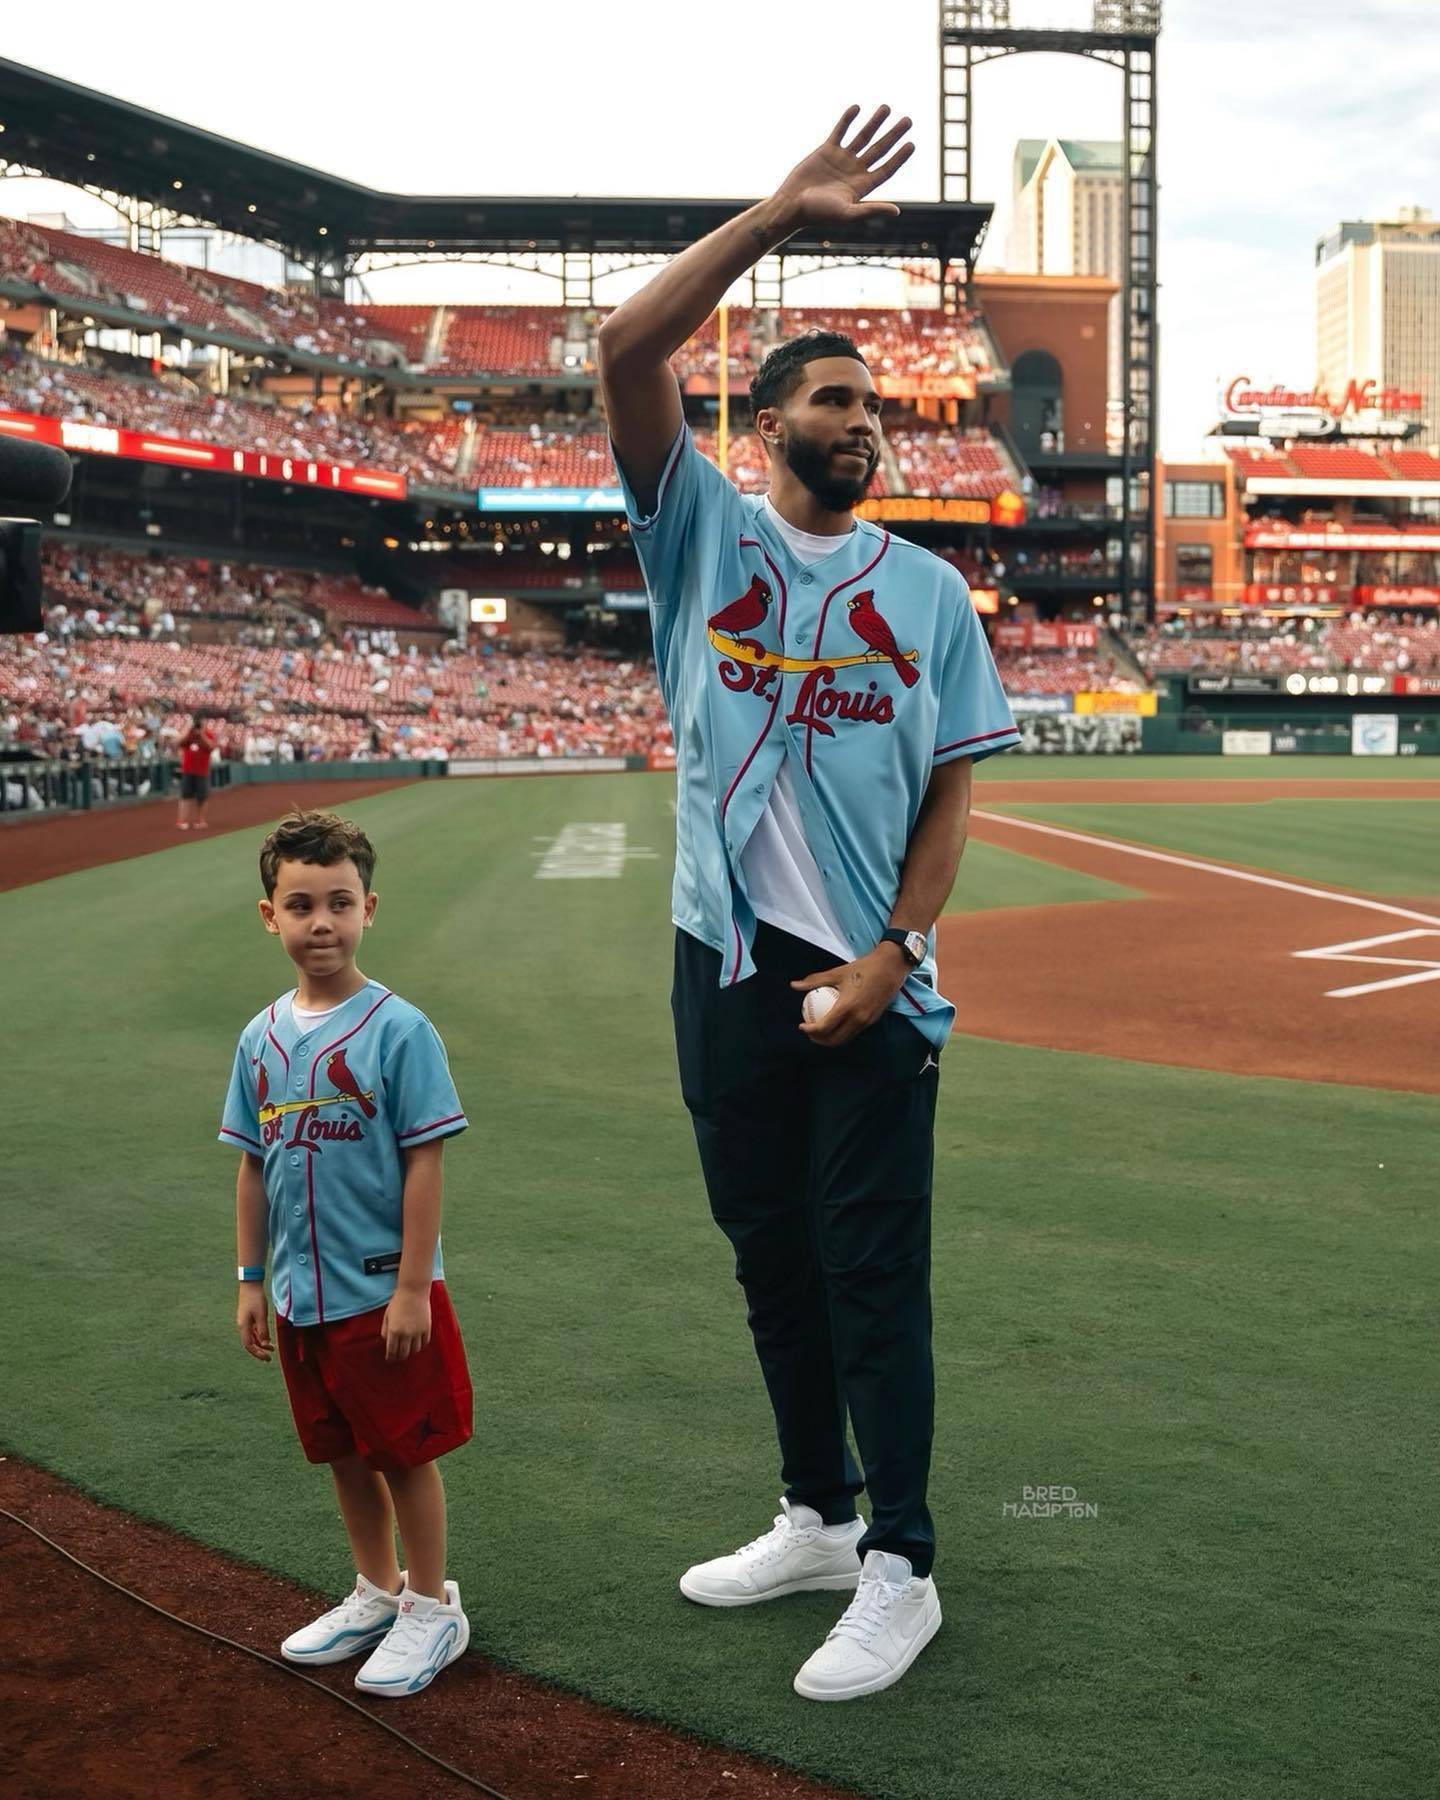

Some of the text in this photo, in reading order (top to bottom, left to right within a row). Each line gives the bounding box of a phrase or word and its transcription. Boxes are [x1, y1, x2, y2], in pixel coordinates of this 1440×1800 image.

[718, 638, 895, 737] St. Louis
[285, 1105, 364, 1154] Louis
